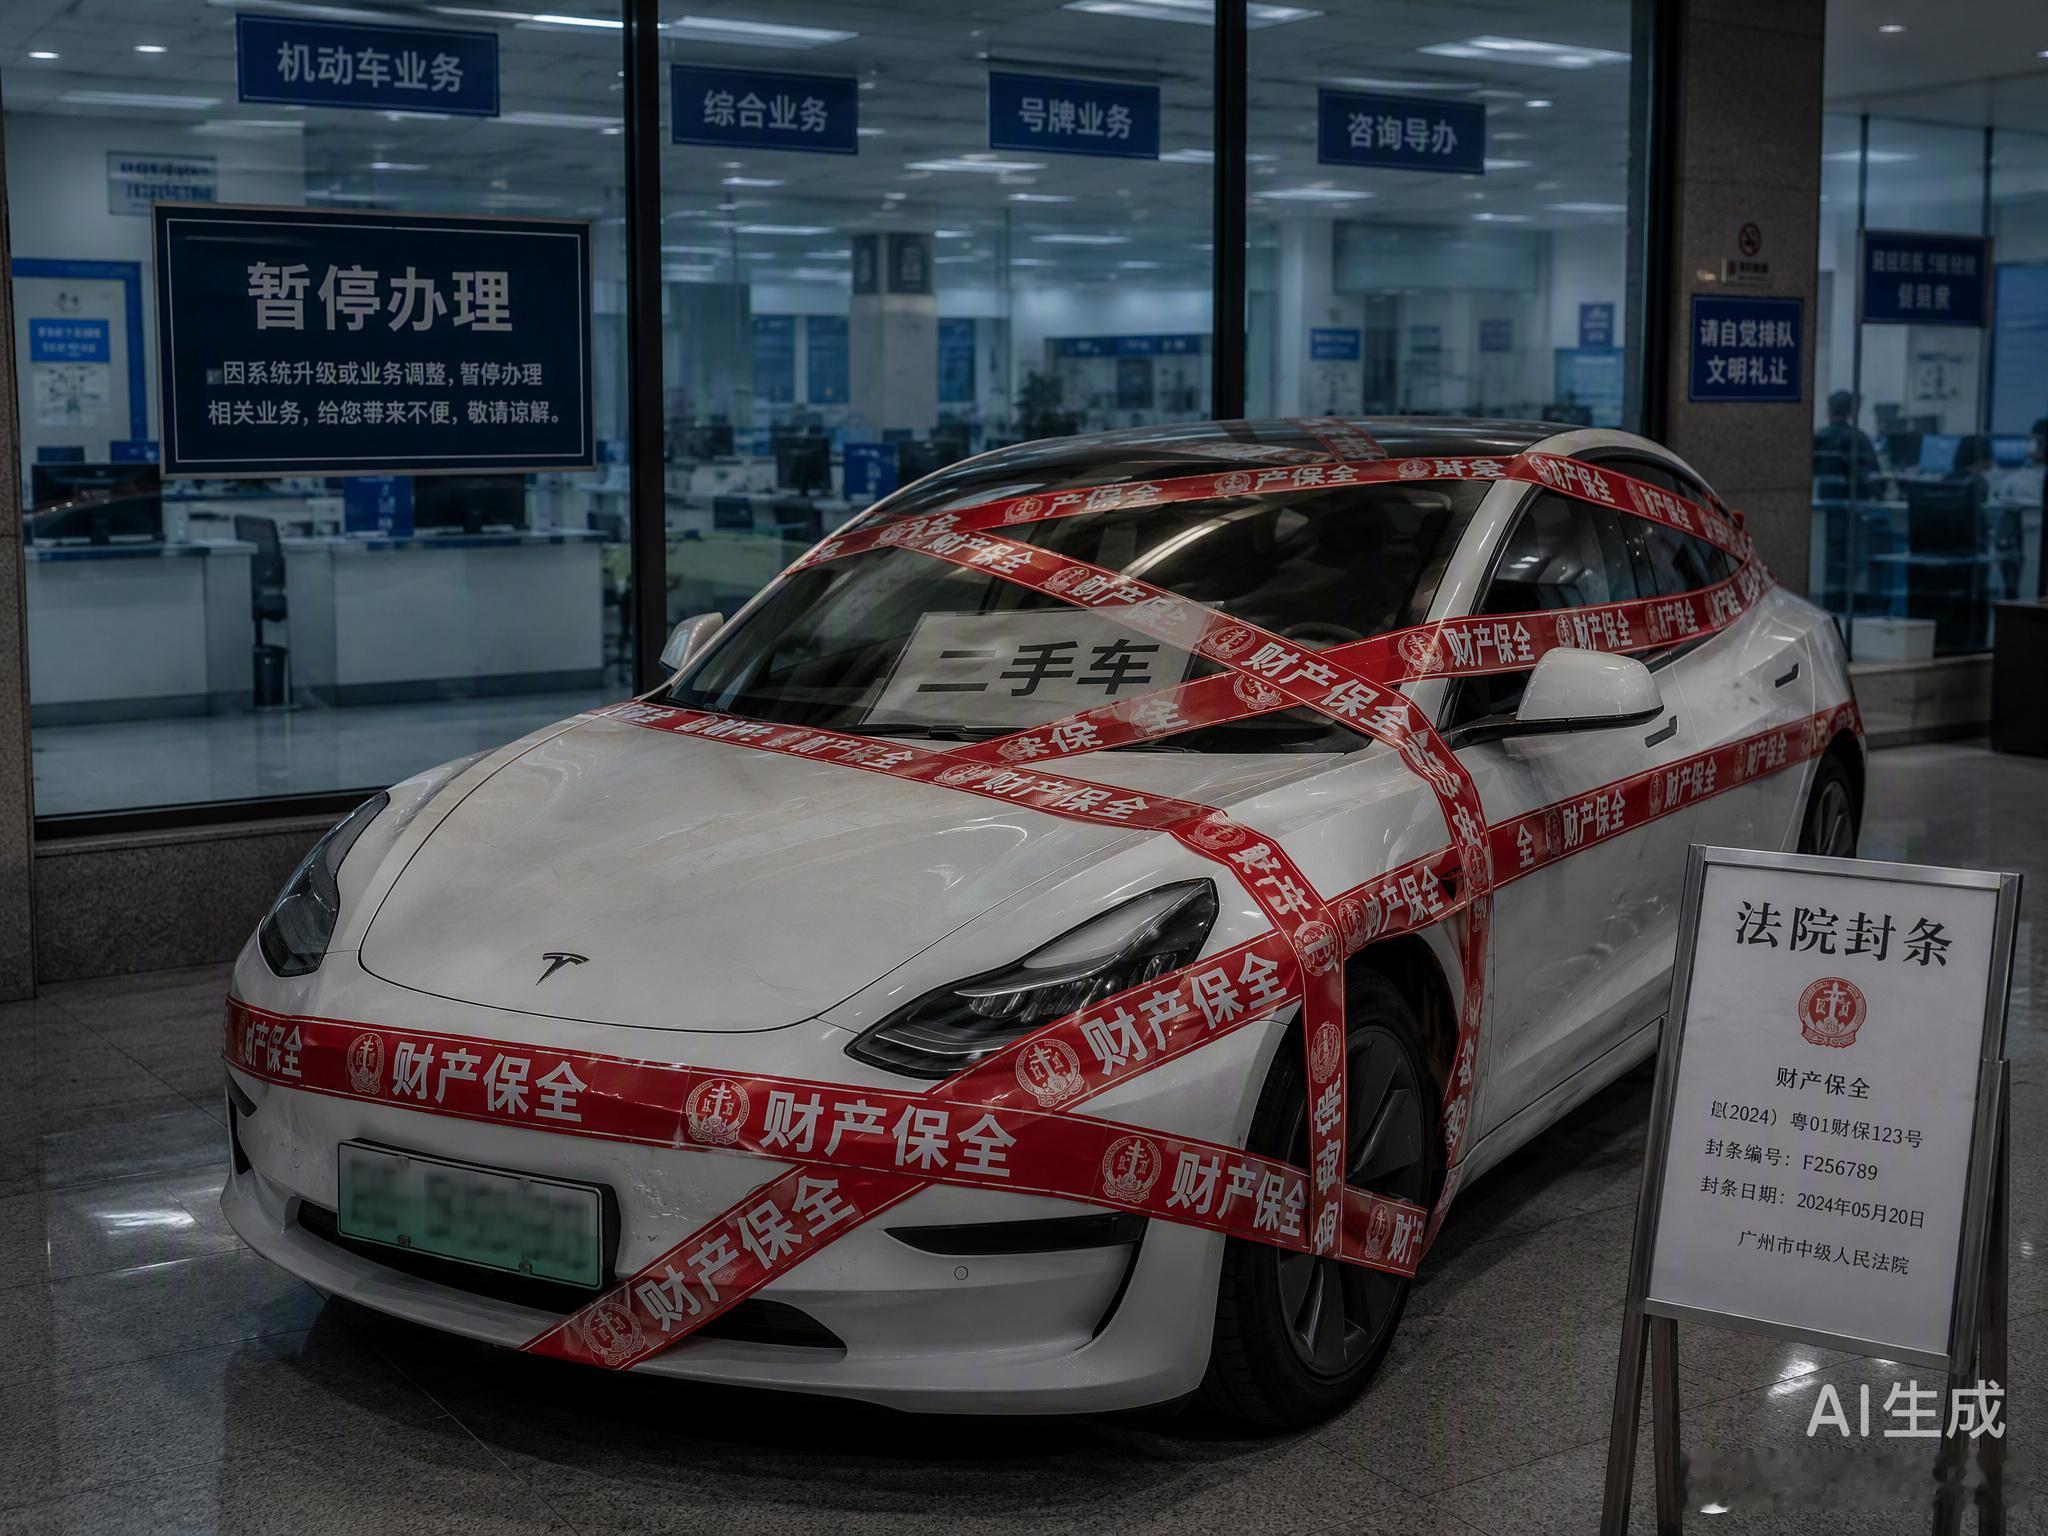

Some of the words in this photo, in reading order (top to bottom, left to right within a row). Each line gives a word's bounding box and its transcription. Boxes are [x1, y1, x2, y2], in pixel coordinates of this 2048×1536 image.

[277, 42, 464, 93] 机动车业务
[702, 90, 831, 134] 综合业务
[1017, 96, 1133, 140] 号牌业务
[1346, 112, 1459, 155] 咨询导办
[246, 260, 514, 333] 暂停办理
[1700, 318, 1796, 348] 请自觉排队
[1706, 355, 1788, 385] 文明礼让
[1442, 621, 1535, 667] 财产保全
[1573, 608, 1633, 649] 财产保全
[917, 638, 1160, 696] 二手车
[1241, 641, 1412, 737] 财产保全
[972, 767, 1150, 820] 财产保全
[1562, 789, 1627, 850] 财产保全
[1665, 756, 1718, 809] 财产保全
[1746, 737, 1788, 779] 财产保全
[1736, 901, 1953, 967] 法院封条
[1079, 952, 1288, 1076] 财产保全
[1775, 1067, 1870, 1099] 财产保全
[392, 1041, 588, 1123] 财产保全
[760, 1090, 1018, 1178] 财产保全
[1166, 1150, 1309, 1238] 财产保全
[634, 1174, 857, 1333] 财产保全
[1737, 1230, 1910, 1275] 广州市中级人民法院
